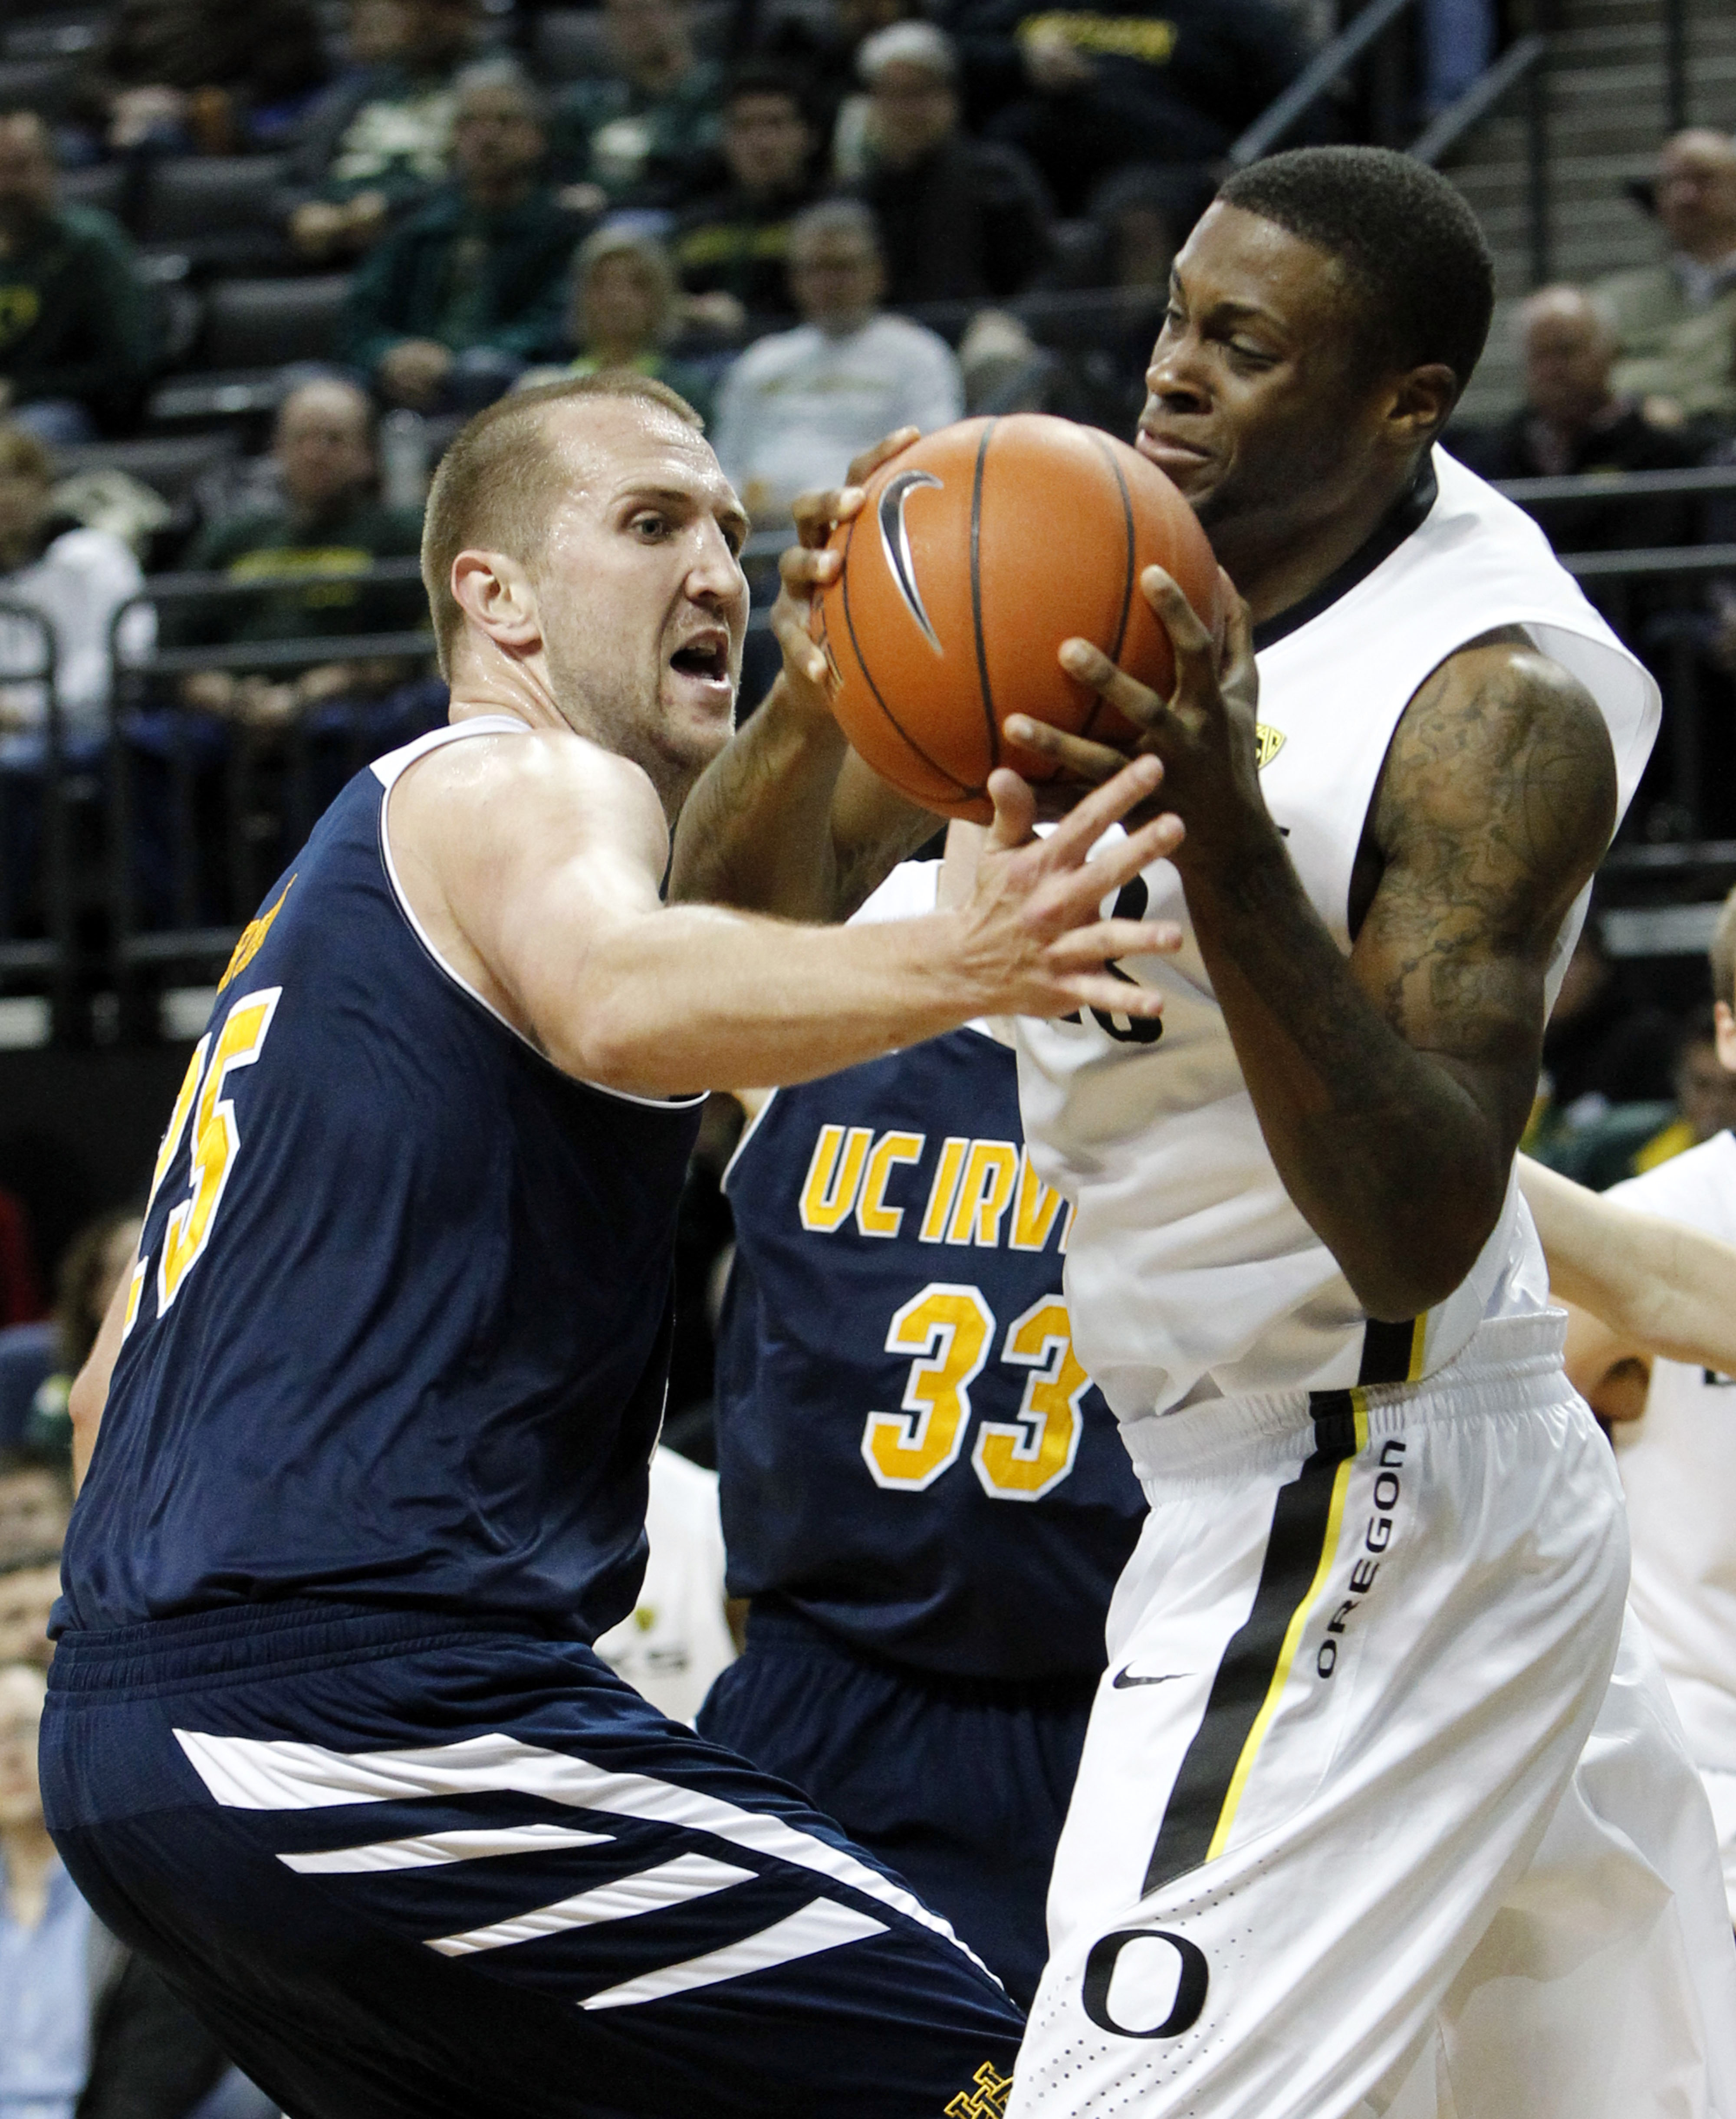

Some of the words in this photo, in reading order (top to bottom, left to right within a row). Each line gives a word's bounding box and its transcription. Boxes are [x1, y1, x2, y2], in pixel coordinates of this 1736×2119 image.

[799, 1124, 926, 1238] UC
[918, 1137, 1078, 1254] IRV
[861, 1282, 1095, 1501] 33
[1317, 1440, 1407, 1678] OREGON
[1082, 1929, 1210, 2038] O
